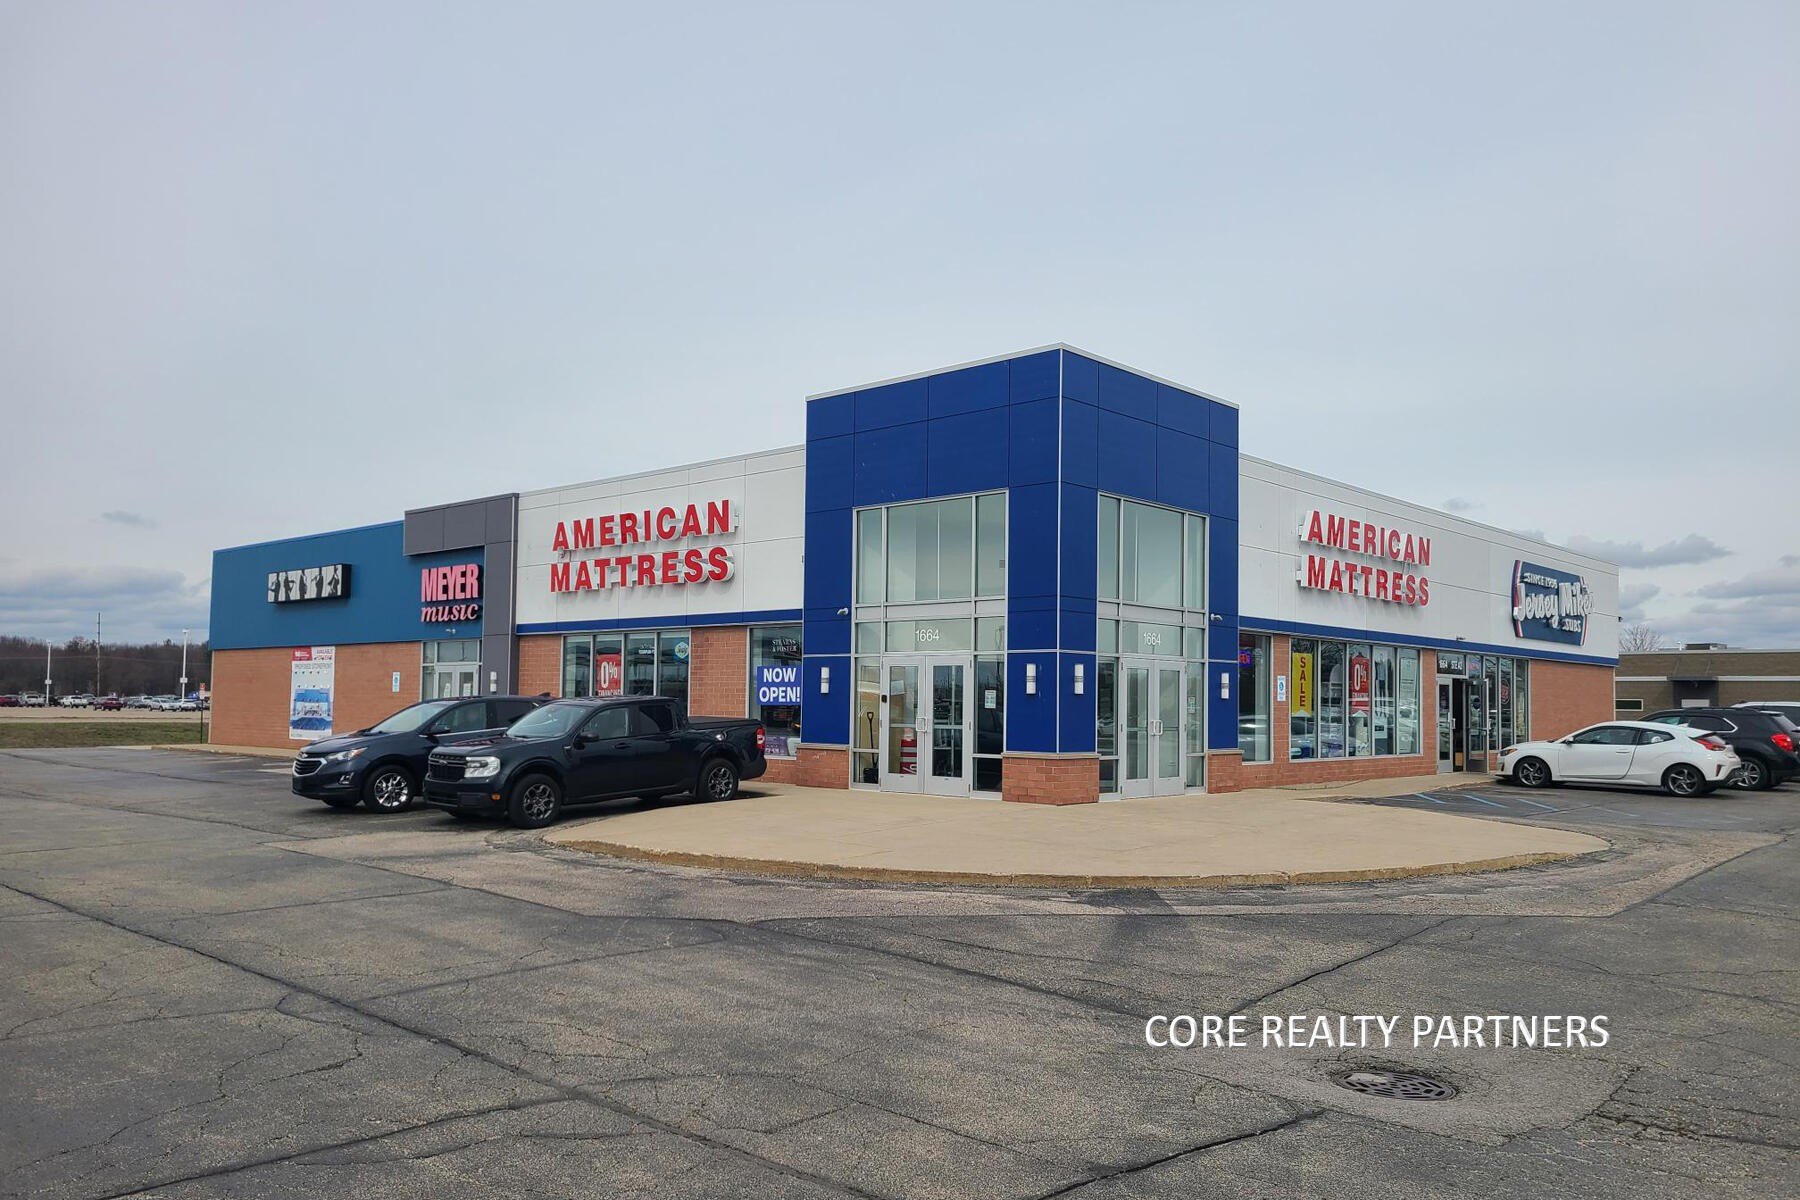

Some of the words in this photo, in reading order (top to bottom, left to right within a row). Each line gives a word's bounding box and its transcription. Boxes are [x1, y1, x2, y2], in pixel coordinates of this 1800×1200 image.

[552, 500, 729, 551] AMERICAN
[1307, 510, 1432, 566] AMERICAN
[421, 563, 479, 602] MEYER
[550, 547, 729, 592] MATTRESS
[1307, 554, 1430, 606] MATTRESS
[421, 603, 479, 622] music
[1513, 583, 1558, 628] Jersey
[915, 628, 940, 643] 1664
[1143, 631, 1161, 647] 1664
[1563, 618, 1581, 632] SUBS
[600, 661, 618, 689] 0%
[764, 668, 796, 682] NOW
[1354, 663, 1367, 691] 0%
[759, 687, 800, 702] OPEN!
